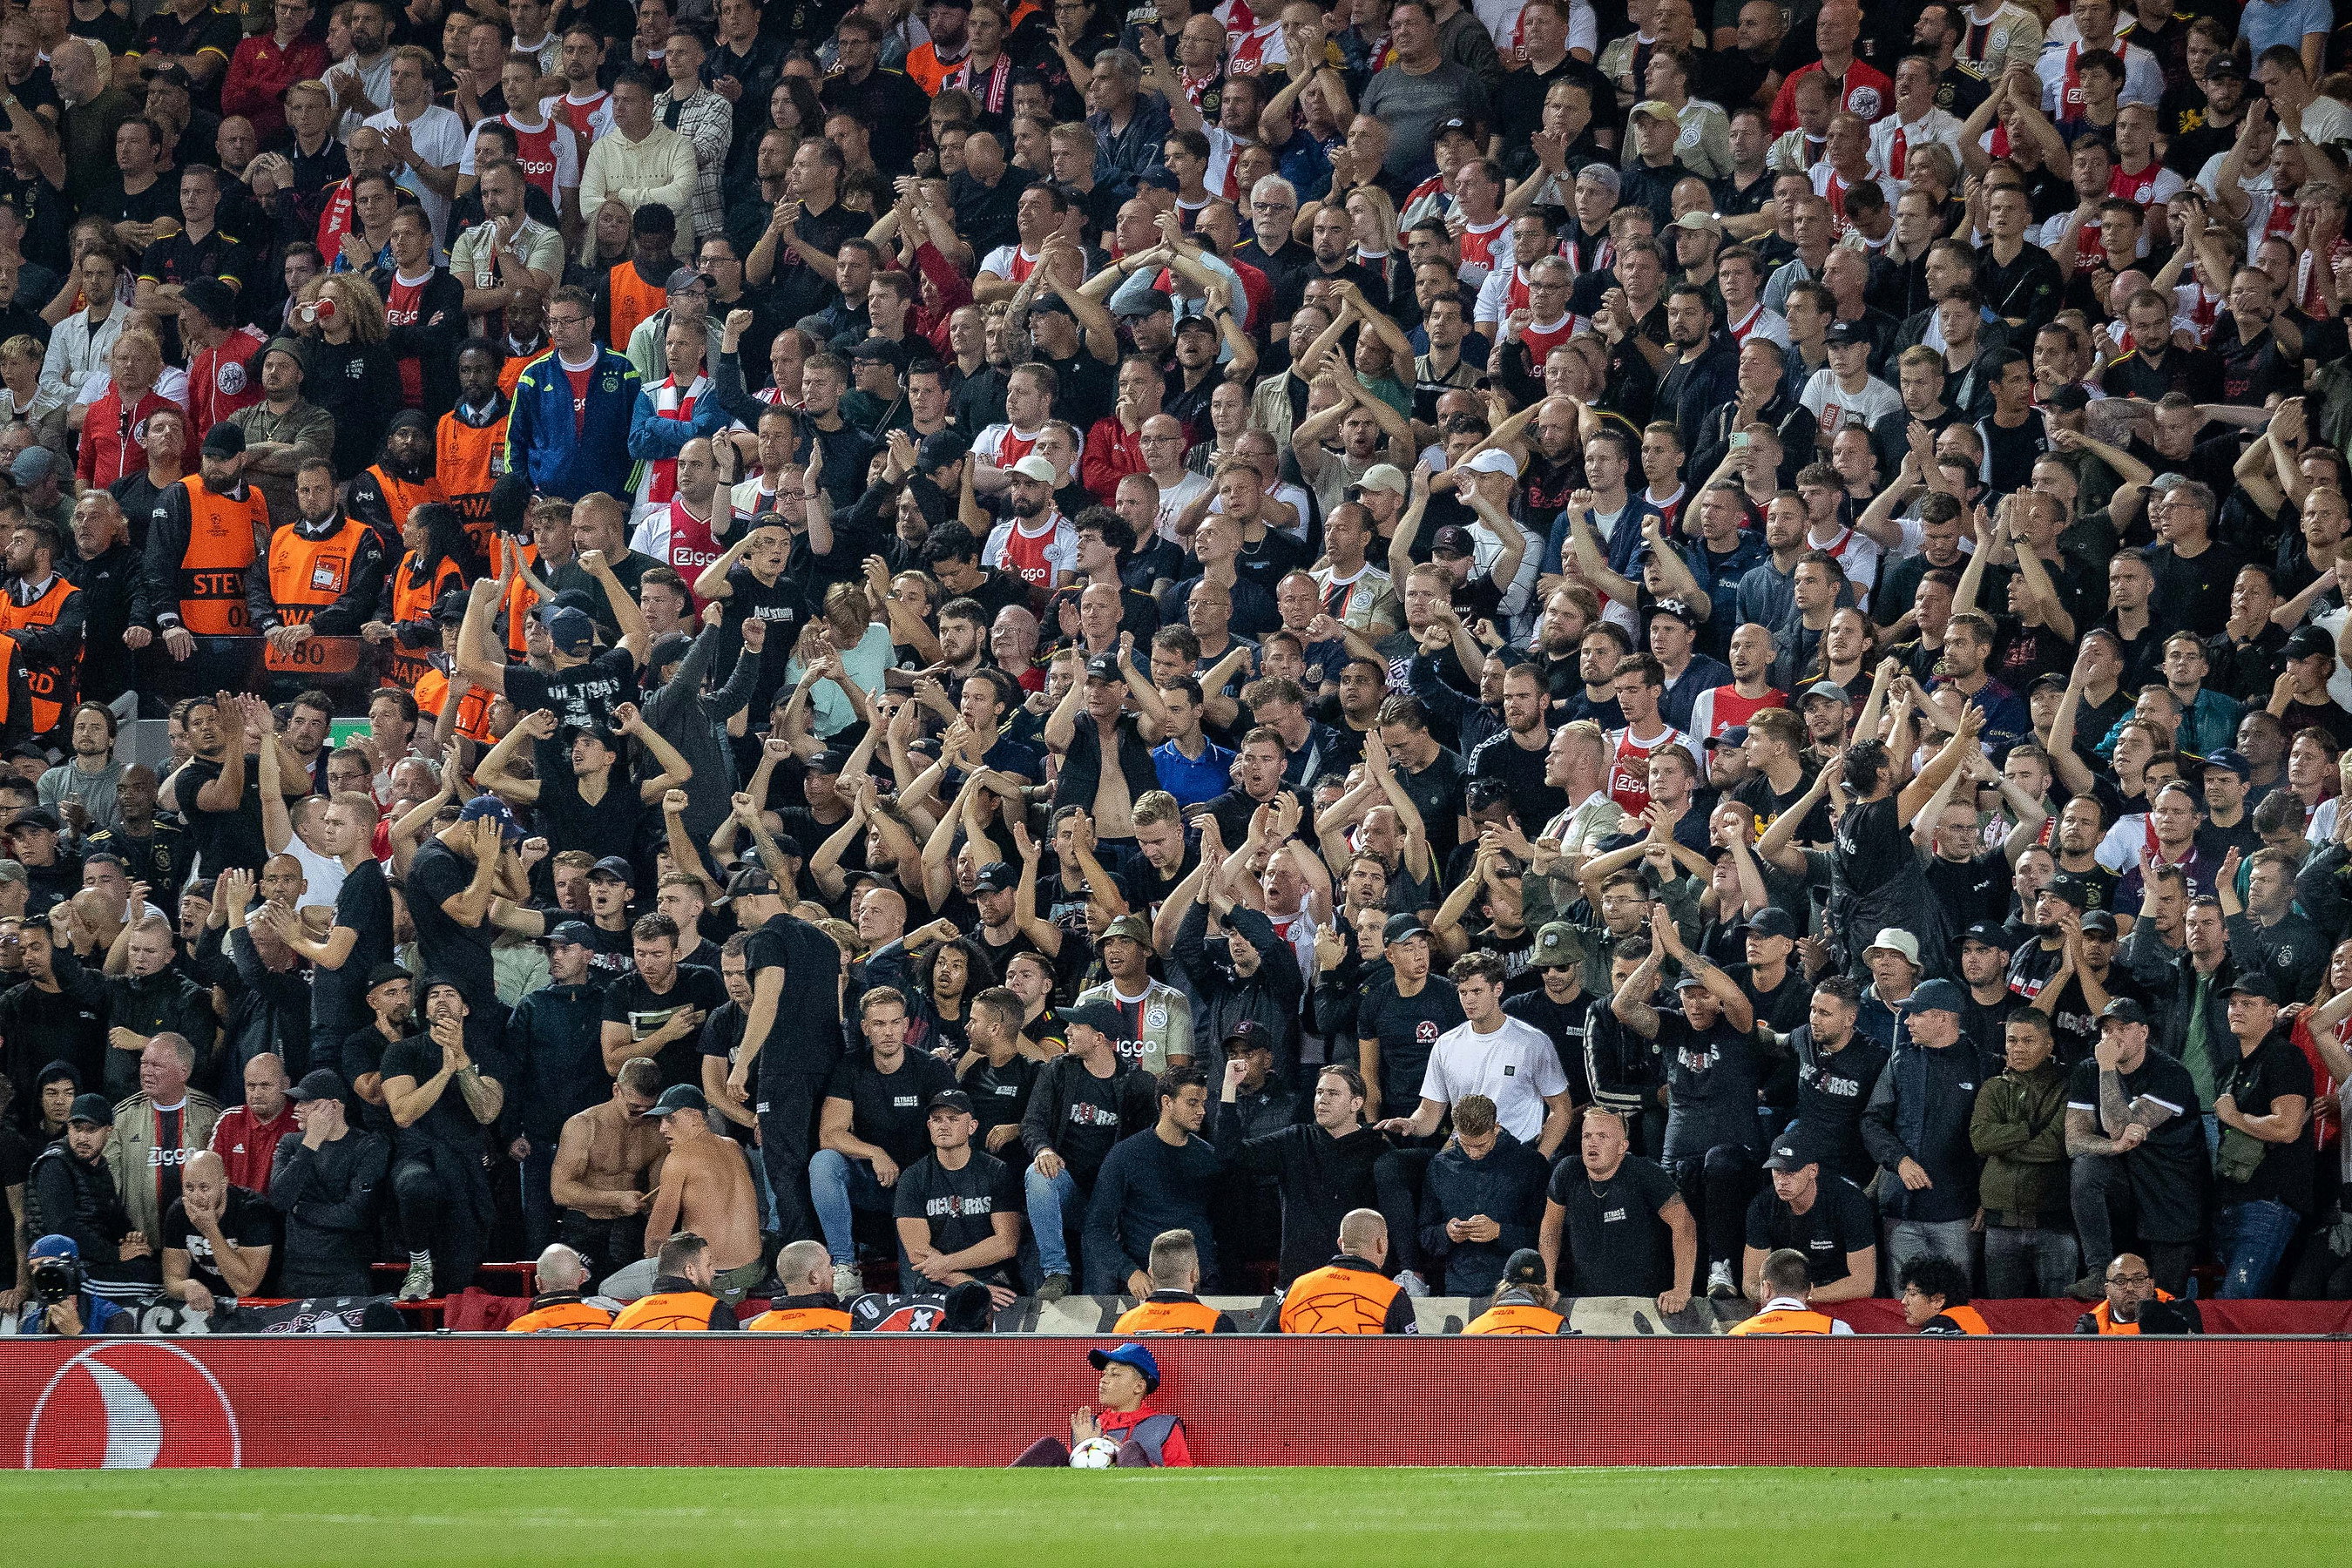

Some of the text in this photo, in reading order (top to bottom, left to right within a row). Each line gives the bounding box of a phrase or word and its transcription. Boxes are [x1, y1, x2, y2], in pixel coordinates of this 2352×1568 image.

[516, 159, 552, 174] iggo
[673, 547, 722, 566] Zigg
[1116, 1037, 1157, 1058] iggo
